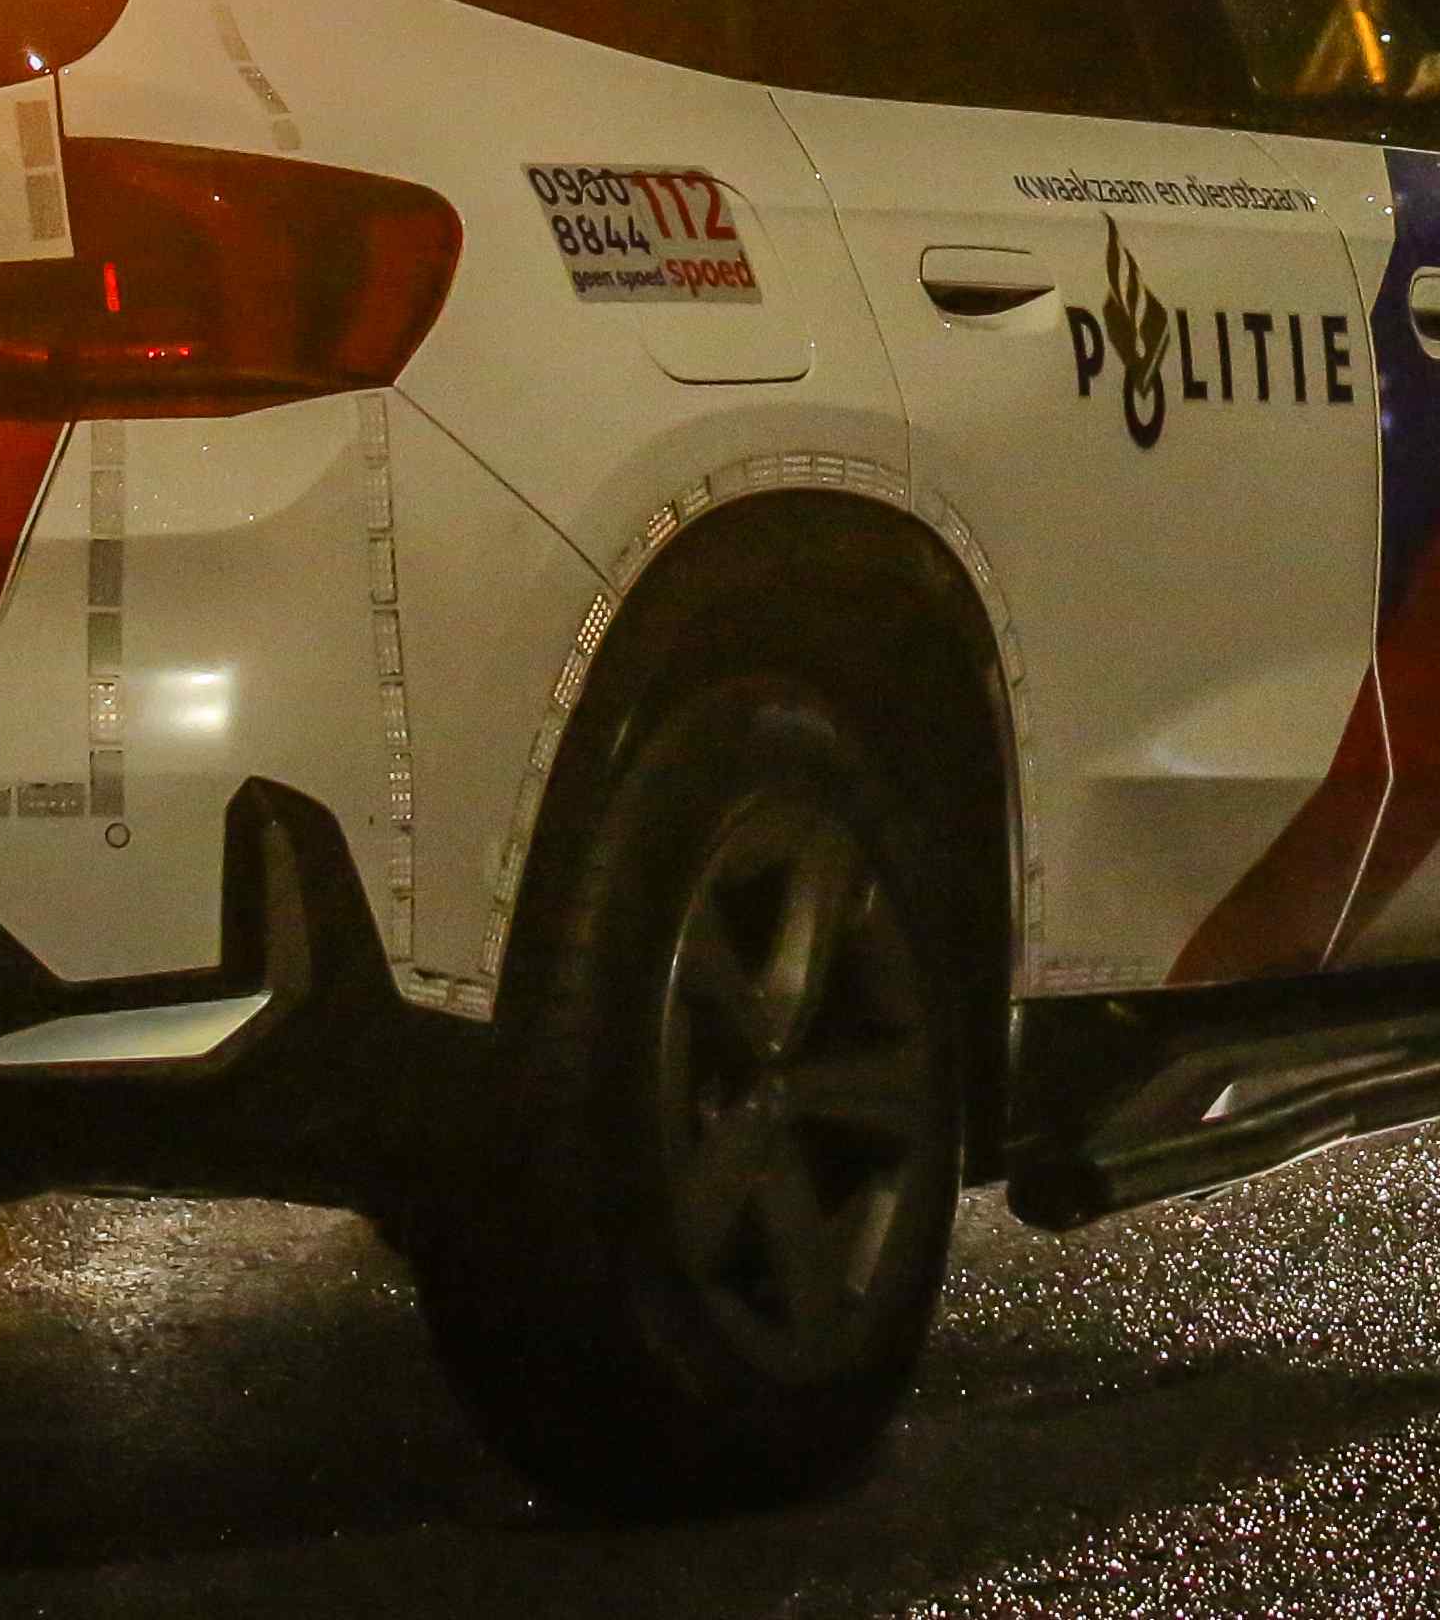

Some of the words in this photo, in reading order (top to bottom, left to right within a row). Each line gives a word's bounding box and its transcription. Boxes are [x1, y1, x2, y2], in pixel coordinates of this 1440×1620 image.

[528, 167, 630, 207] 0900
[629, 169, 737, 240] 112
[1154, 180, 1185, 206] en
[551, 213, 651, 256] 8844
[572, 268, 616, 293] geen
[615, 266, 668, 292] spoed
[665, 249, 757, 298] spoed
[1064, 302, 1356, 448] POLITIE
